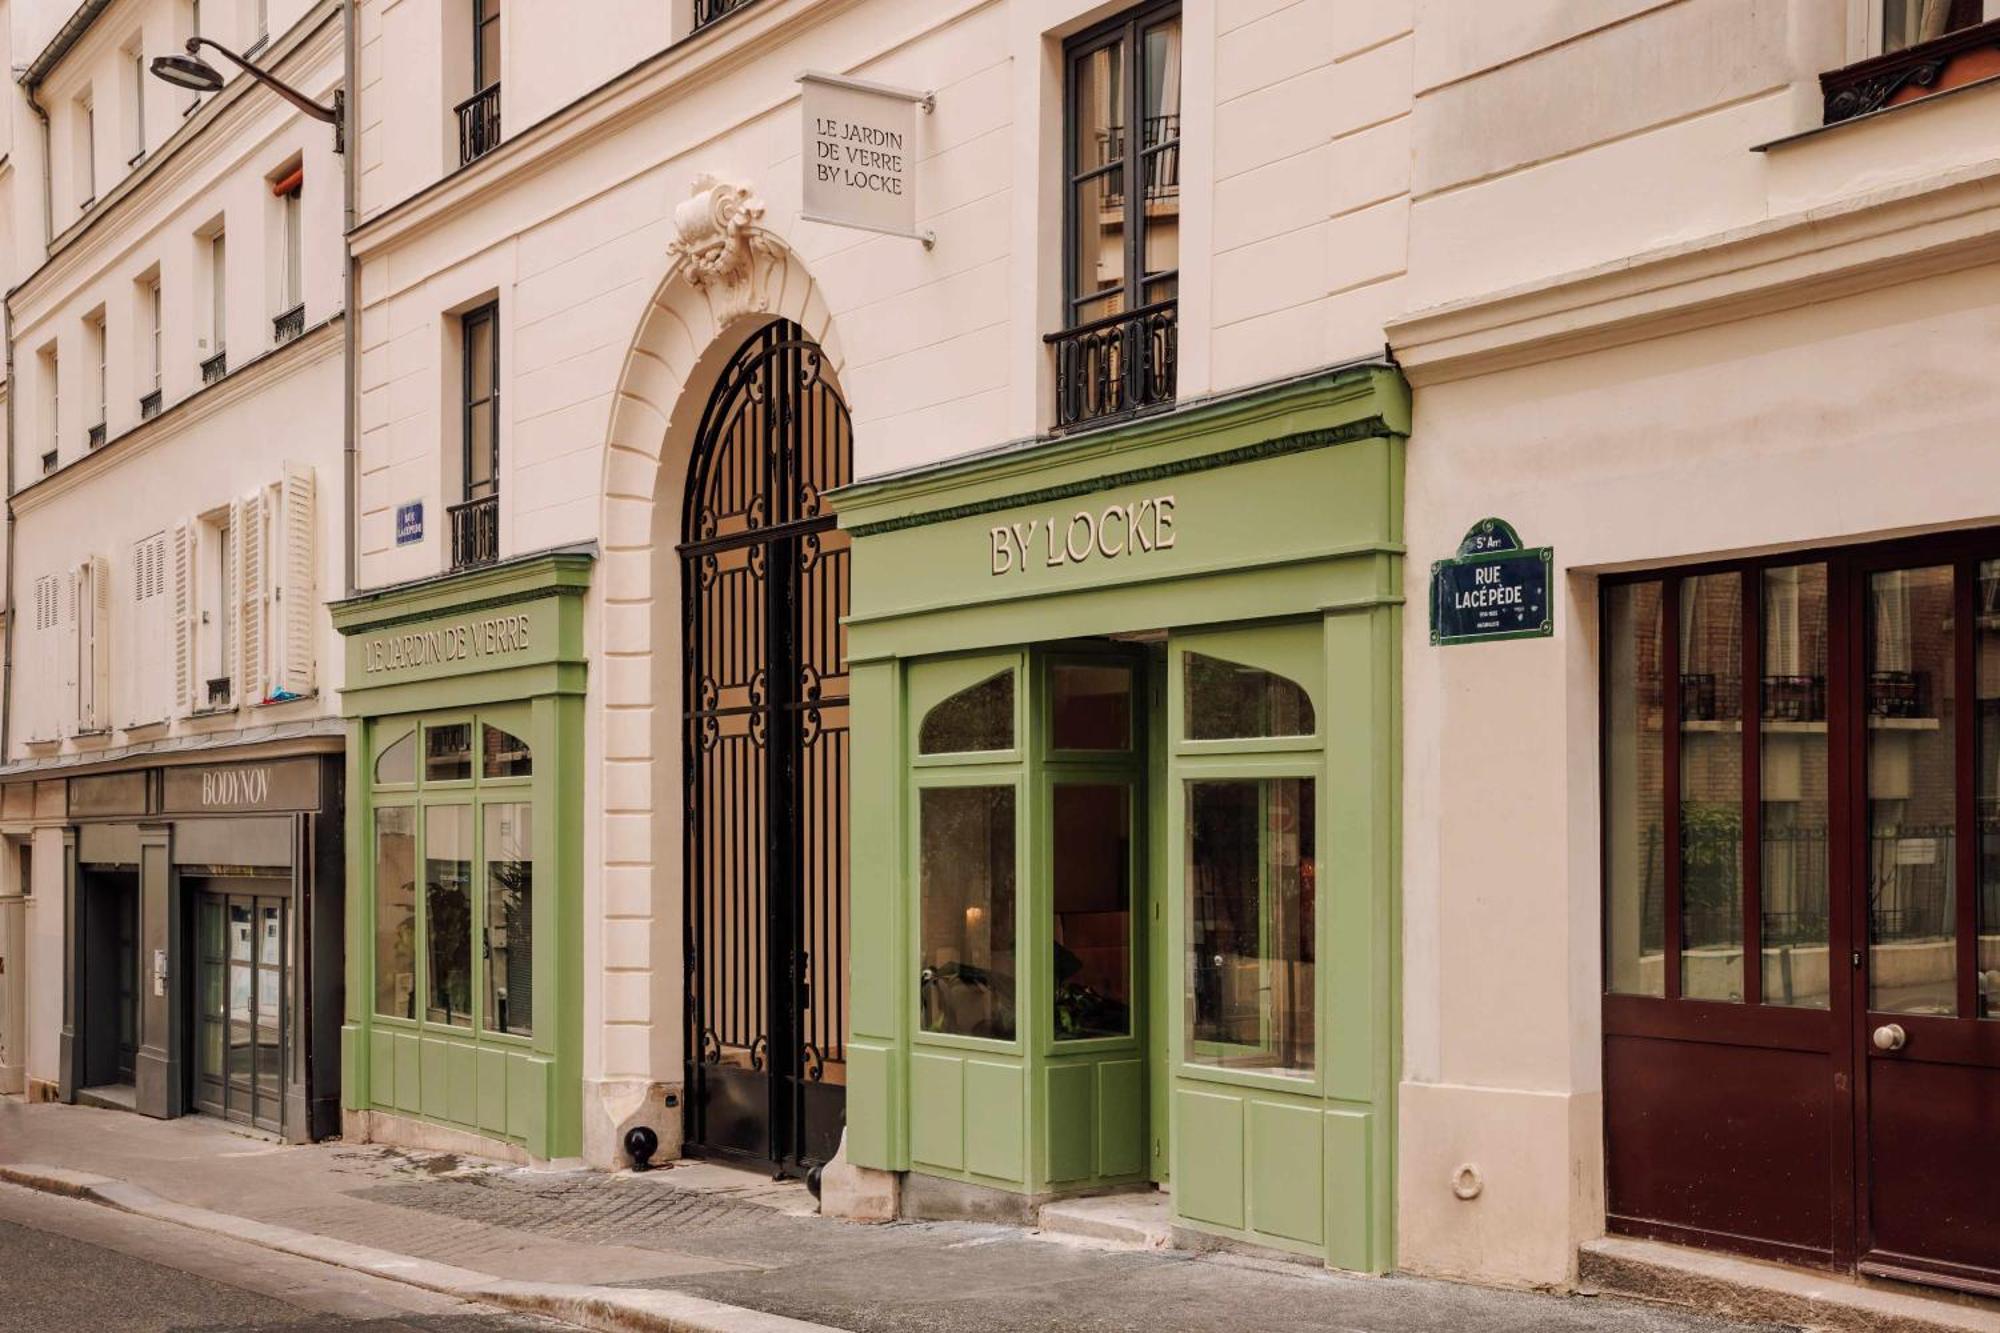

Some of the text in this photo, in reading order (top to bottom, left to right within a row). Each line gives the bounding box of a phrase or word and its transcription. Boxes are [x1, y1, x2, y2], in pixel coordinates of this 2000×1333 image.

[816, 118, 902, 150] LE JARDIN
[816, 141, 902, 173] DE VERRE
[816, 163, 902, 195] BY LOCKE
[990, 495, 1177, 576] BY LOCKE
[1475, 565, 1501, 585] RUE
[1455, 584, 1522, 609] LACÉPÈDE
[365, 614, 529, 672] LE JARDIN DE VERRE
[202, 767, 272, 805] BODYNOV
